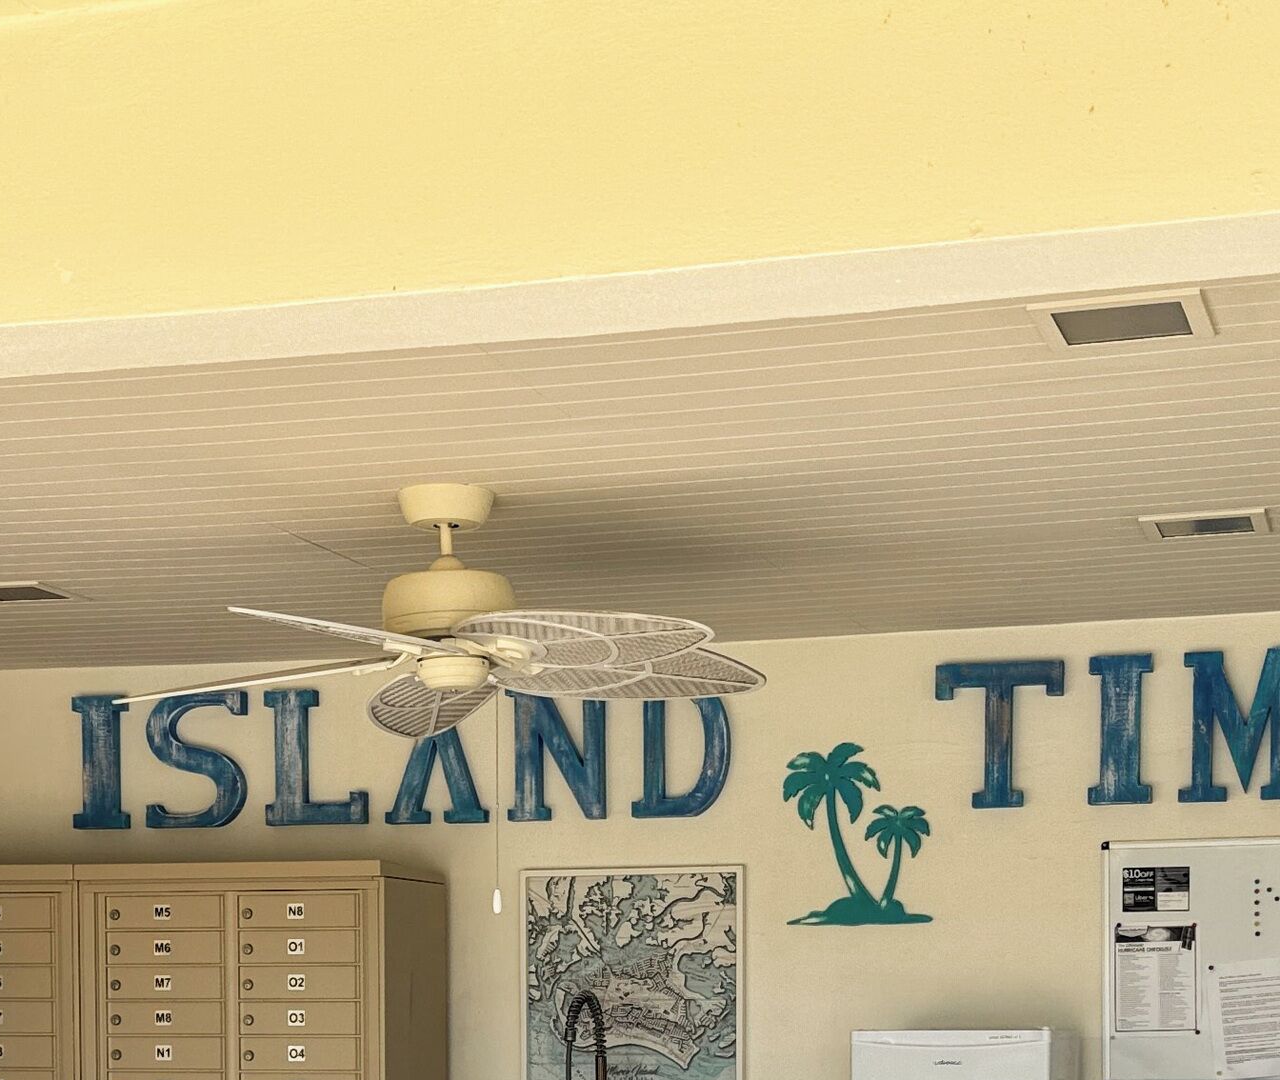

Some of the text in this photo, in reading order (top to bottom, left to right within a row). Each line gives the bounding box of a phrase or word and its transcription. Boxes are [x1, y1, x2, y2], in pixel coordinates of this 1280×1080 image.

[71, 688, 730, 830] ISLAND
[154, 907, 171, 918] M5
[288, 906, 304, 917] N8
[154, 942, 172, 953] M6
[288, 941, 303, 952] O1
[155, 977, 172, 988] M7
[288, 977, 305, 988] O2
[155, 1012, 172, 1023] M8
[289, 1012, 305, 1024] O3
[156, 1047, 170, 1058] N1
[289, 1048, 305, 1059] O4
